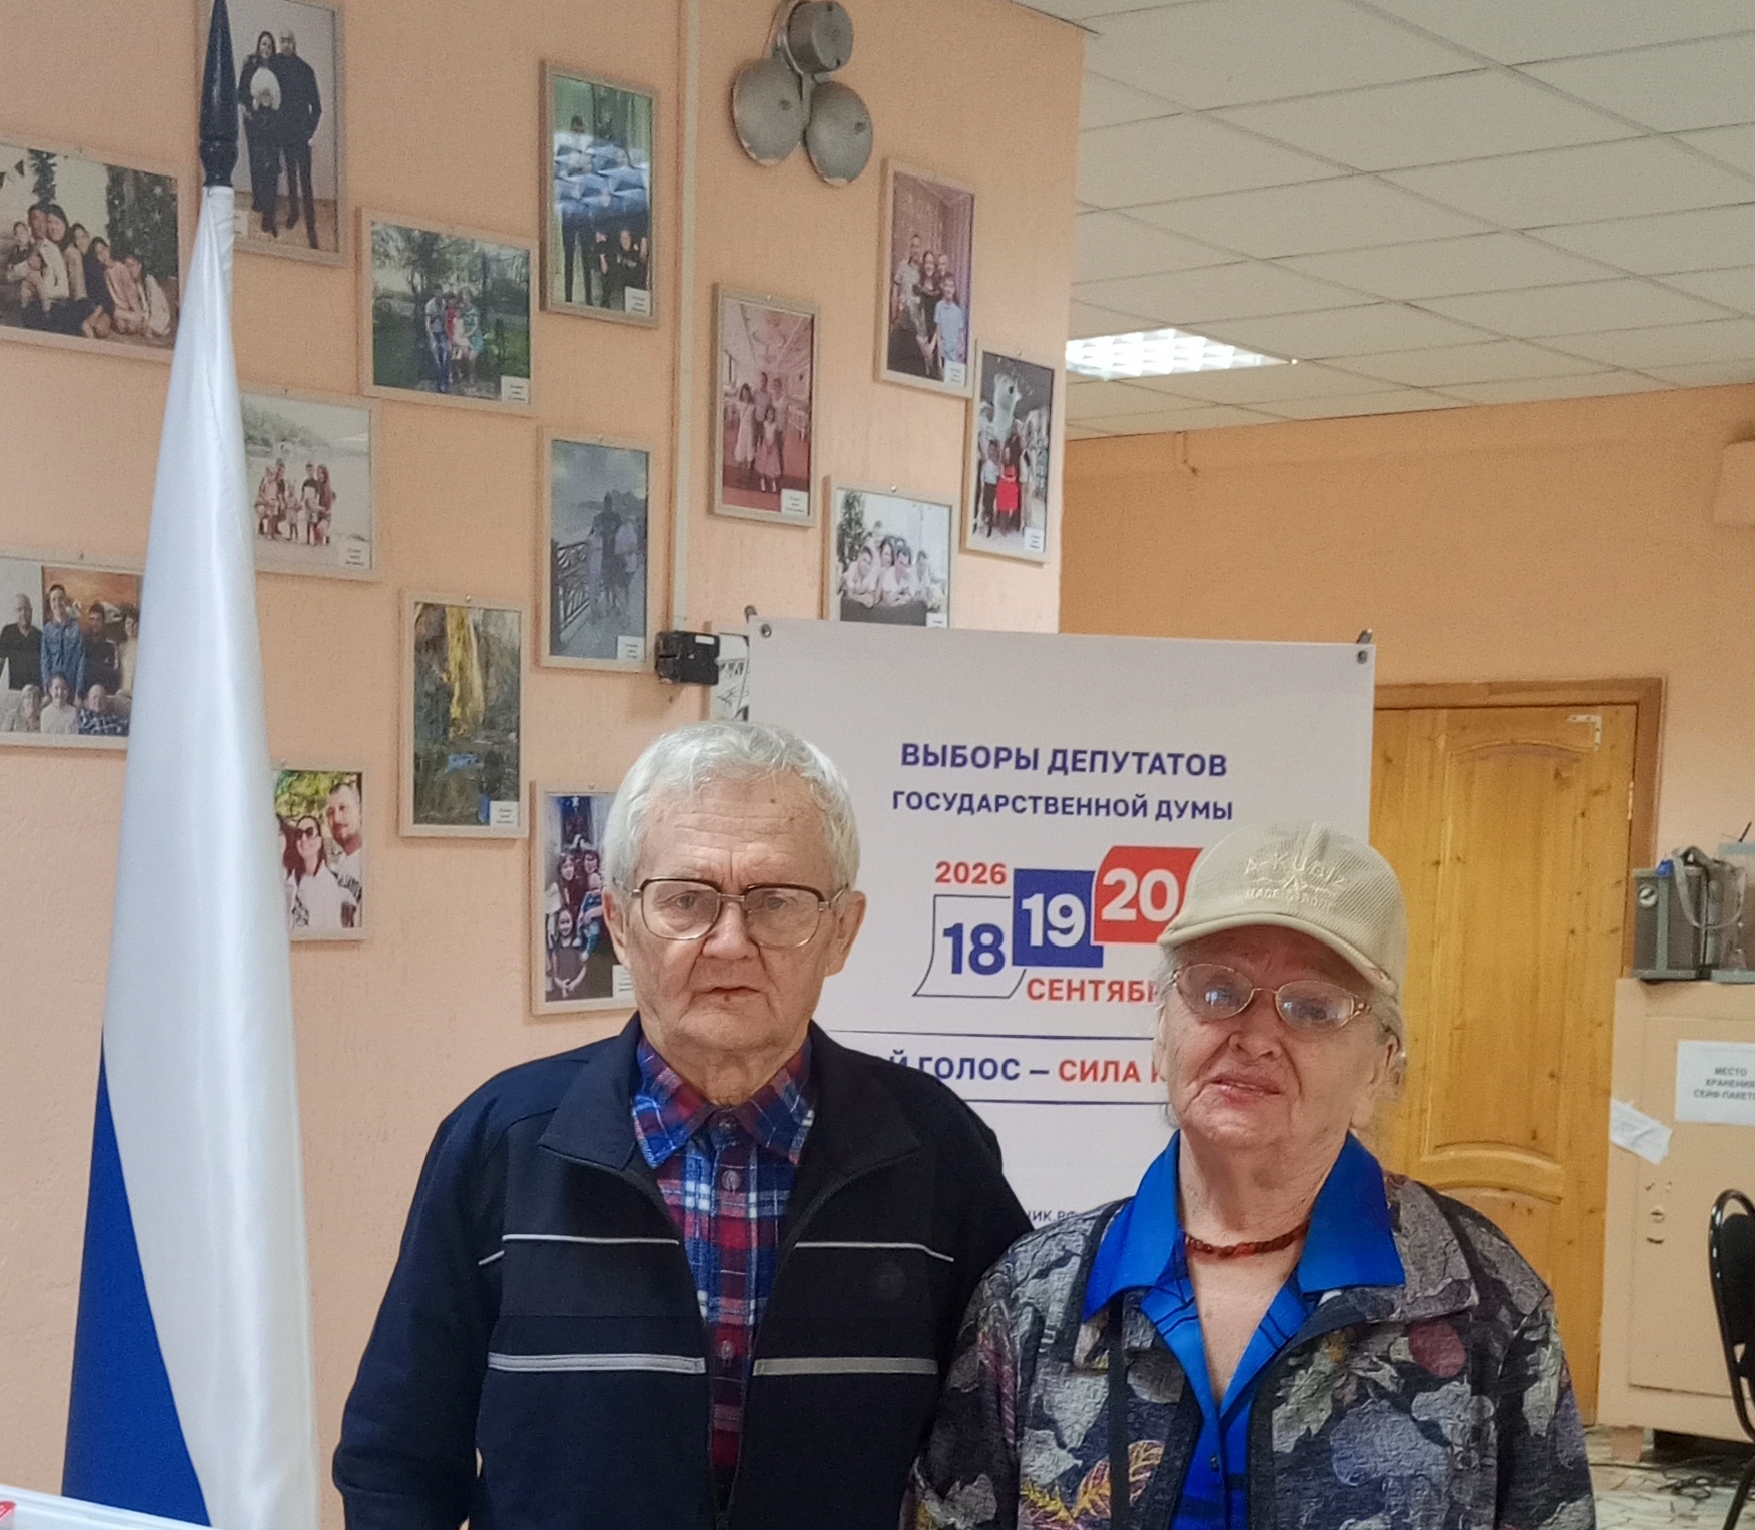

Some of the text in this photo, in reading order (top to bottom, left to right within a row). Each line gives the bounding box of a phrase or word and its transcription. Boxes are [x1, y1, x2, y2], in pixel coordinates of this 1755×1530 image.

[901, 743, 1227, 777] ВЫБОРЫ ДЕПУТАТОВ
[892, 790, 1233, 822] ГОСУДАРСТВЕННОЙ ДУМЫ
[935, 861, 1008, 885] 2026
[1101, 867, 1180, 922] 20
[1021, 892, 1087, 948] 19
[943, 922, 1007, 976] 18
[919, 1057, 1021, 1081] ГОЛОС
[1058, 1060, 1142, 1083] СИЛА
